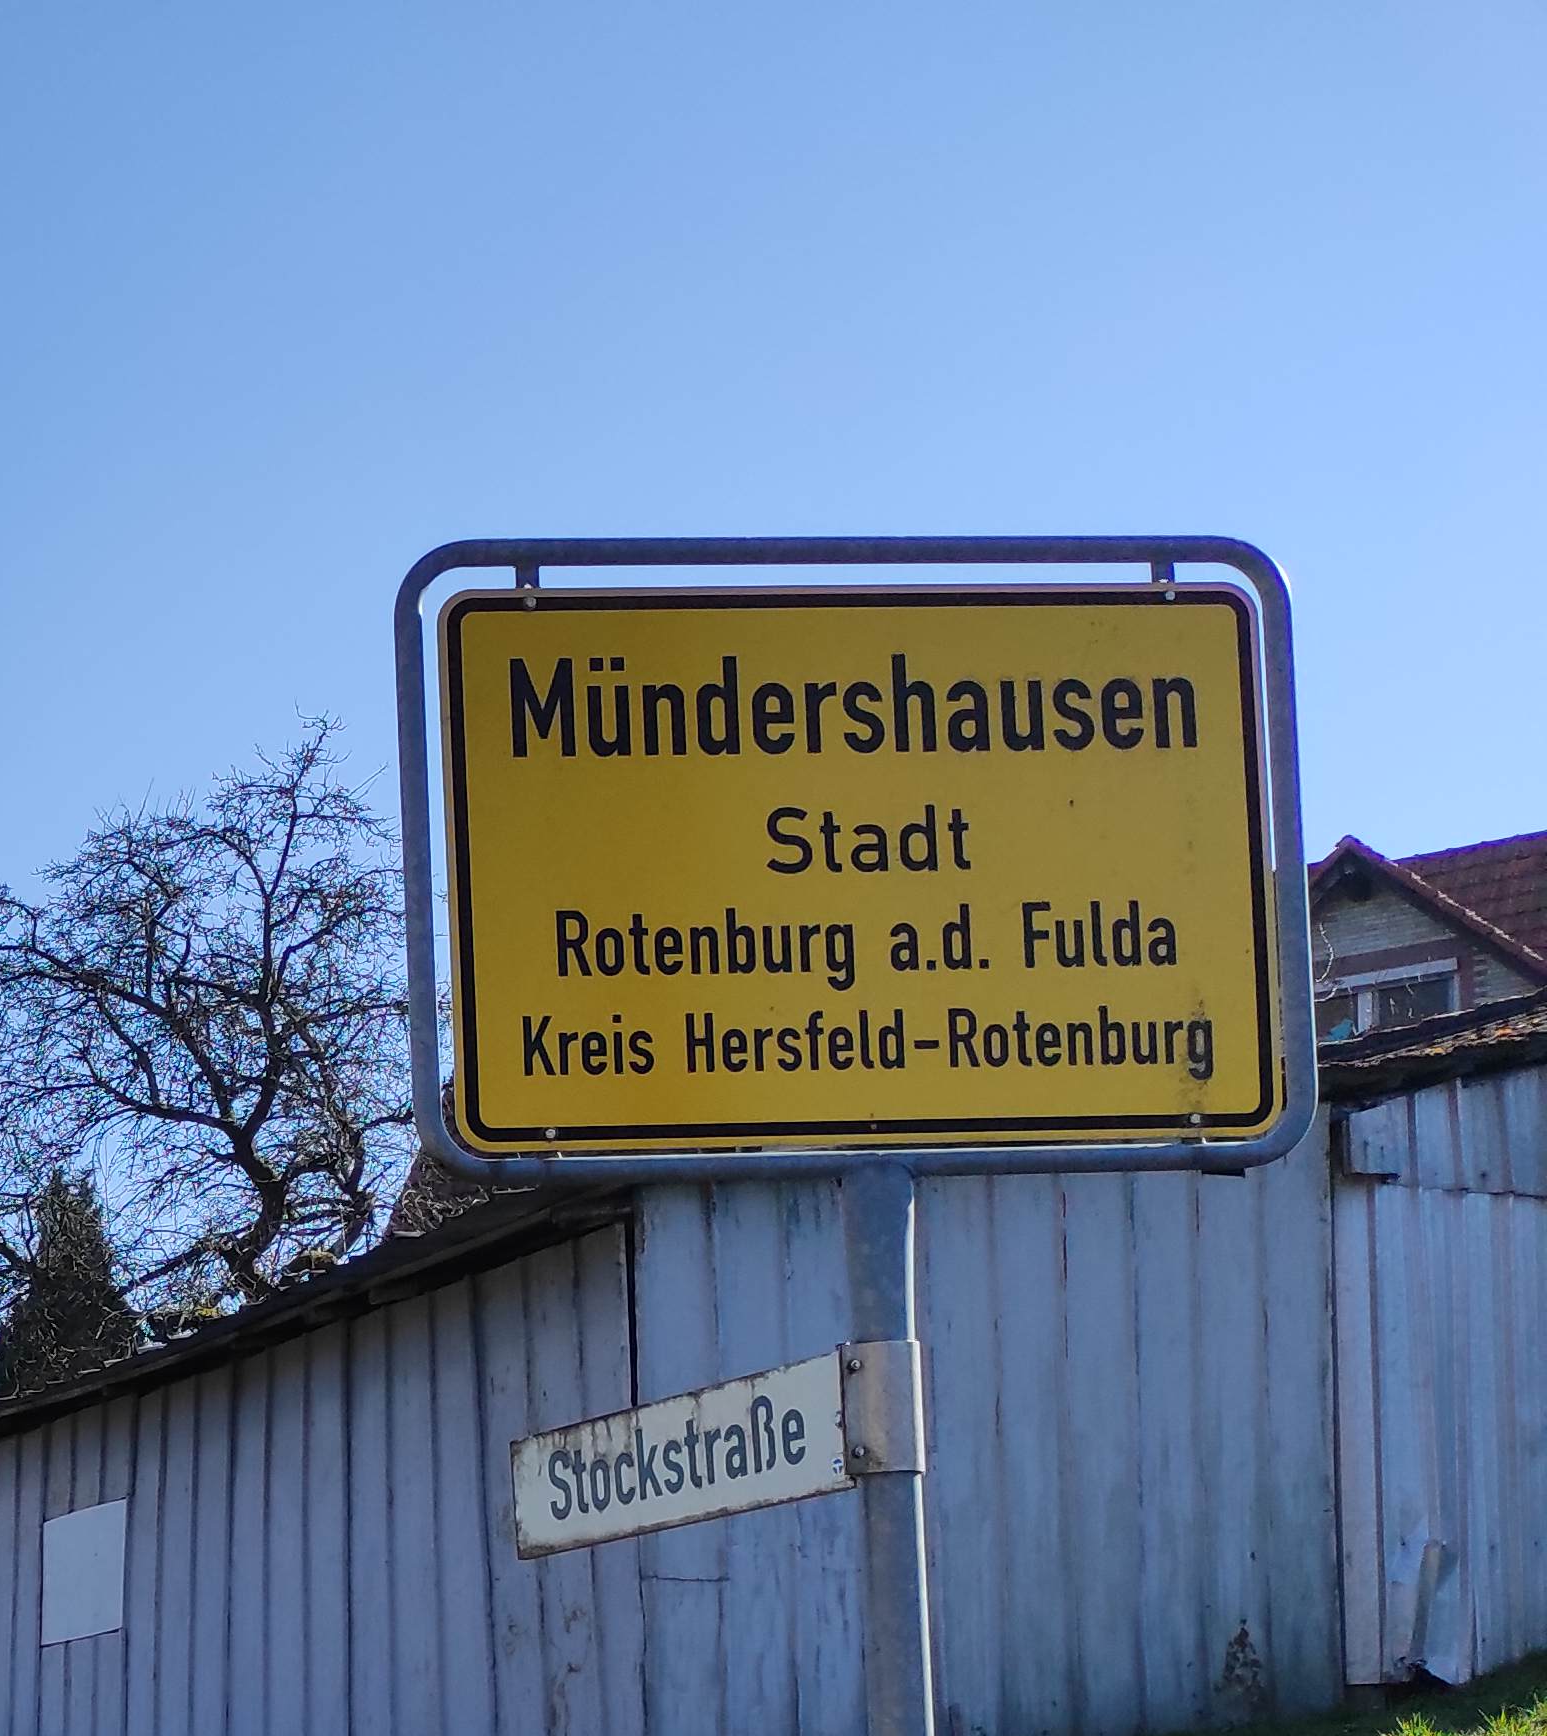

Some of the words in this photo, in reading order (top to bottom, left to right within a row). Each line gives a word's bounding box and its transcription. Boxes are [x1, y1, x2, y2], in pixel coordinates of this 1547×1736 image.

[509, 653, 1198, 759] Mündershausen
[766, 805, 972, 875] Stadt
[556, 909, 856, 991] Rotenburg
[889, 903, 990, 971] a.d.
[1022, 900, 1178, 969] Fulda
[523, 1014, 654, 1077] Kreis
[686, 1003, 1215, 1081] Hersfeld-Rotenburg
[548, 1395, 806, 1521] Stockstraße
